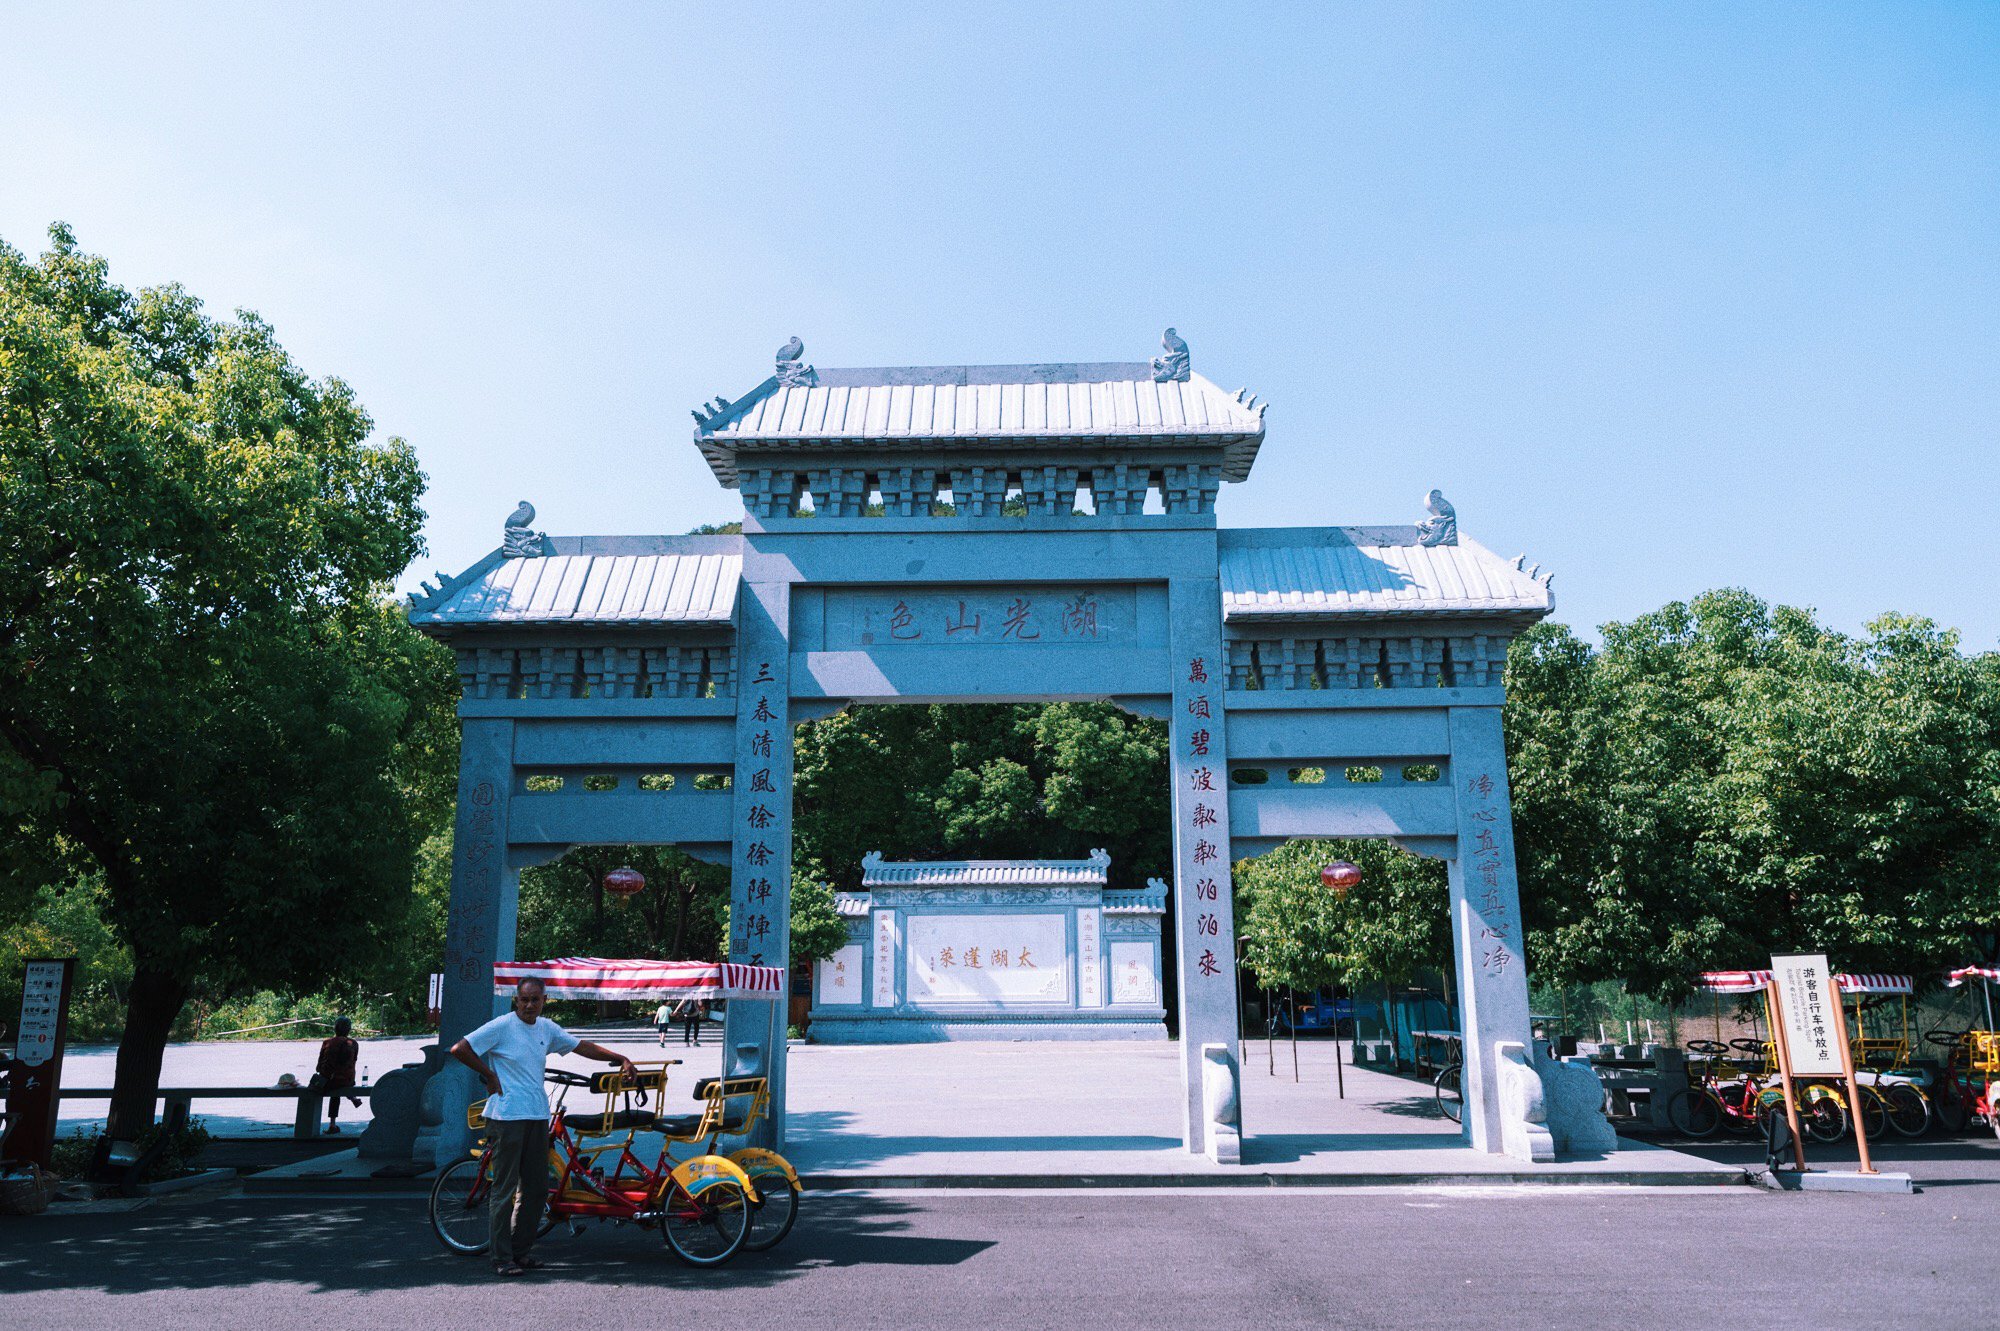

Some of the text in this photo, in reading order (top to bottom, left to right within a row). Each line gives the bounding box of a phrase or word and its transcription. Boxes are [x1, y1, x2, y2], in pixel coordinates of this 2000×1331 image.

[890, 598, 1098, 640] 湖光山色
[1803, 968, 1830, 1061] 游客自行车停放点
